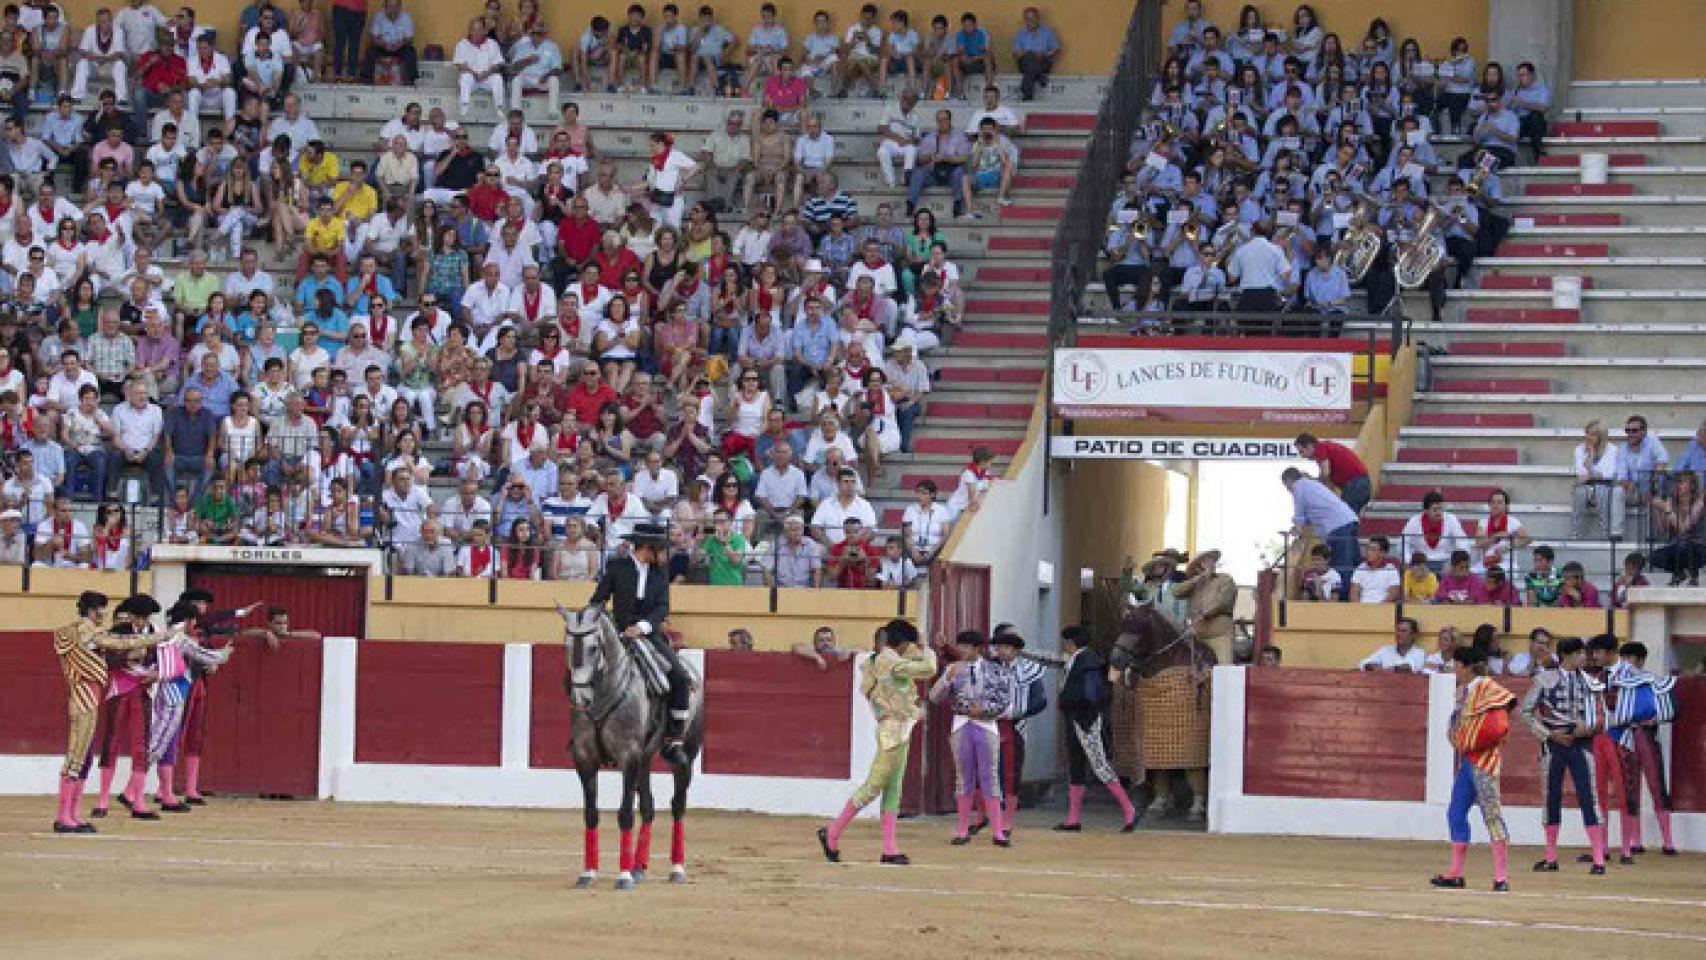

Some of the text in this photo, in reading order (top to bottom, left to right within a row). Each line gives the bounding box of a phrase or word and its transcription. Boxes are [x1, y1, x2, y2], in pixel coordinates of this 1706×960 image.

[1117, 362, 1290, 392] LANCES DE FUTURO
[1075, 440, 1297, 457] PATIO DE CUADRIL
[232, 550, 302, 560] TORILES
